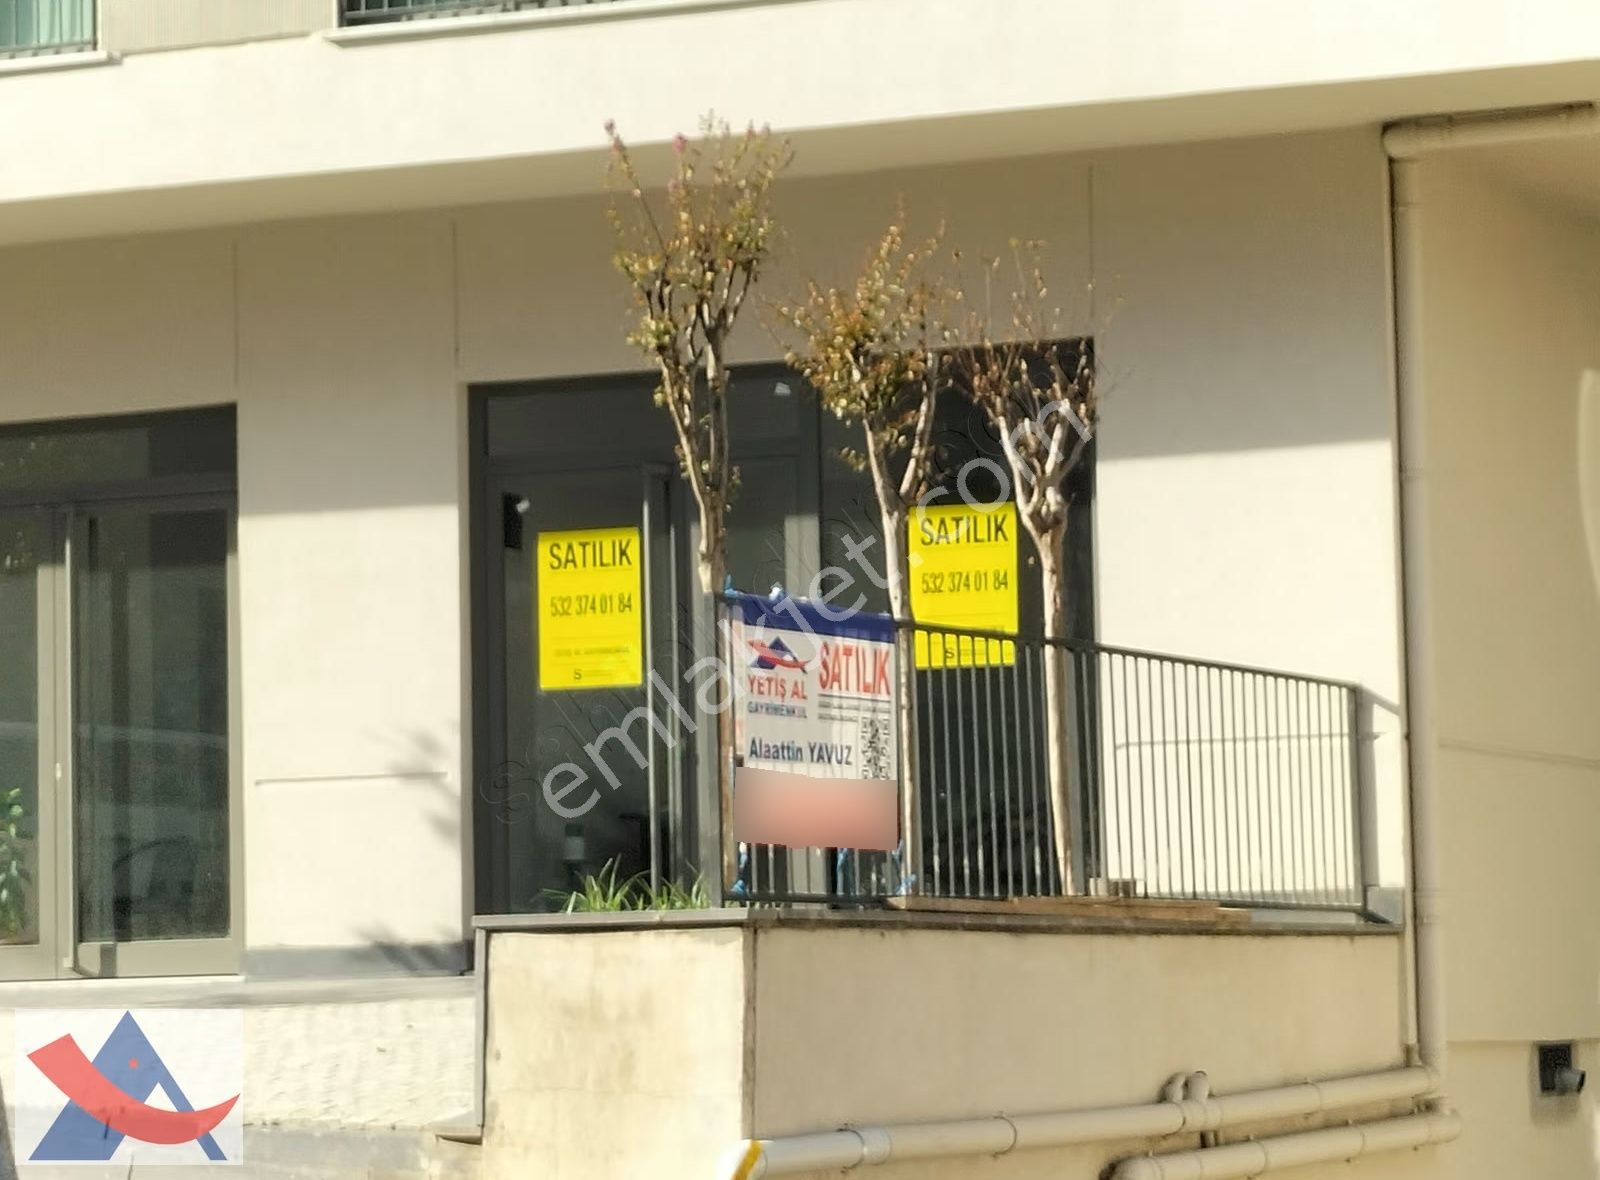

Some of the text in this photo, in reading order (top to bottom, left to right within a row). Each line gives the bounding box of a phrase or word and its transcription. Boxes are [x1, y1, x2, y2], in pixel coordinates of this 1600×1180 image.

[921, 513, 1009, 546] SATILIK
[549, 539, 632, 570] SATILIK
[922, 569, 1009, 594] 532 374 01 84
[550, 592, 632, 617] 532 374 01 84
[818, 640, 891, 696] SATILIK
[747, 674, 808, 703] YETİŞ AL
[749, 737, 853, 766] Alaattin YAVUZ
